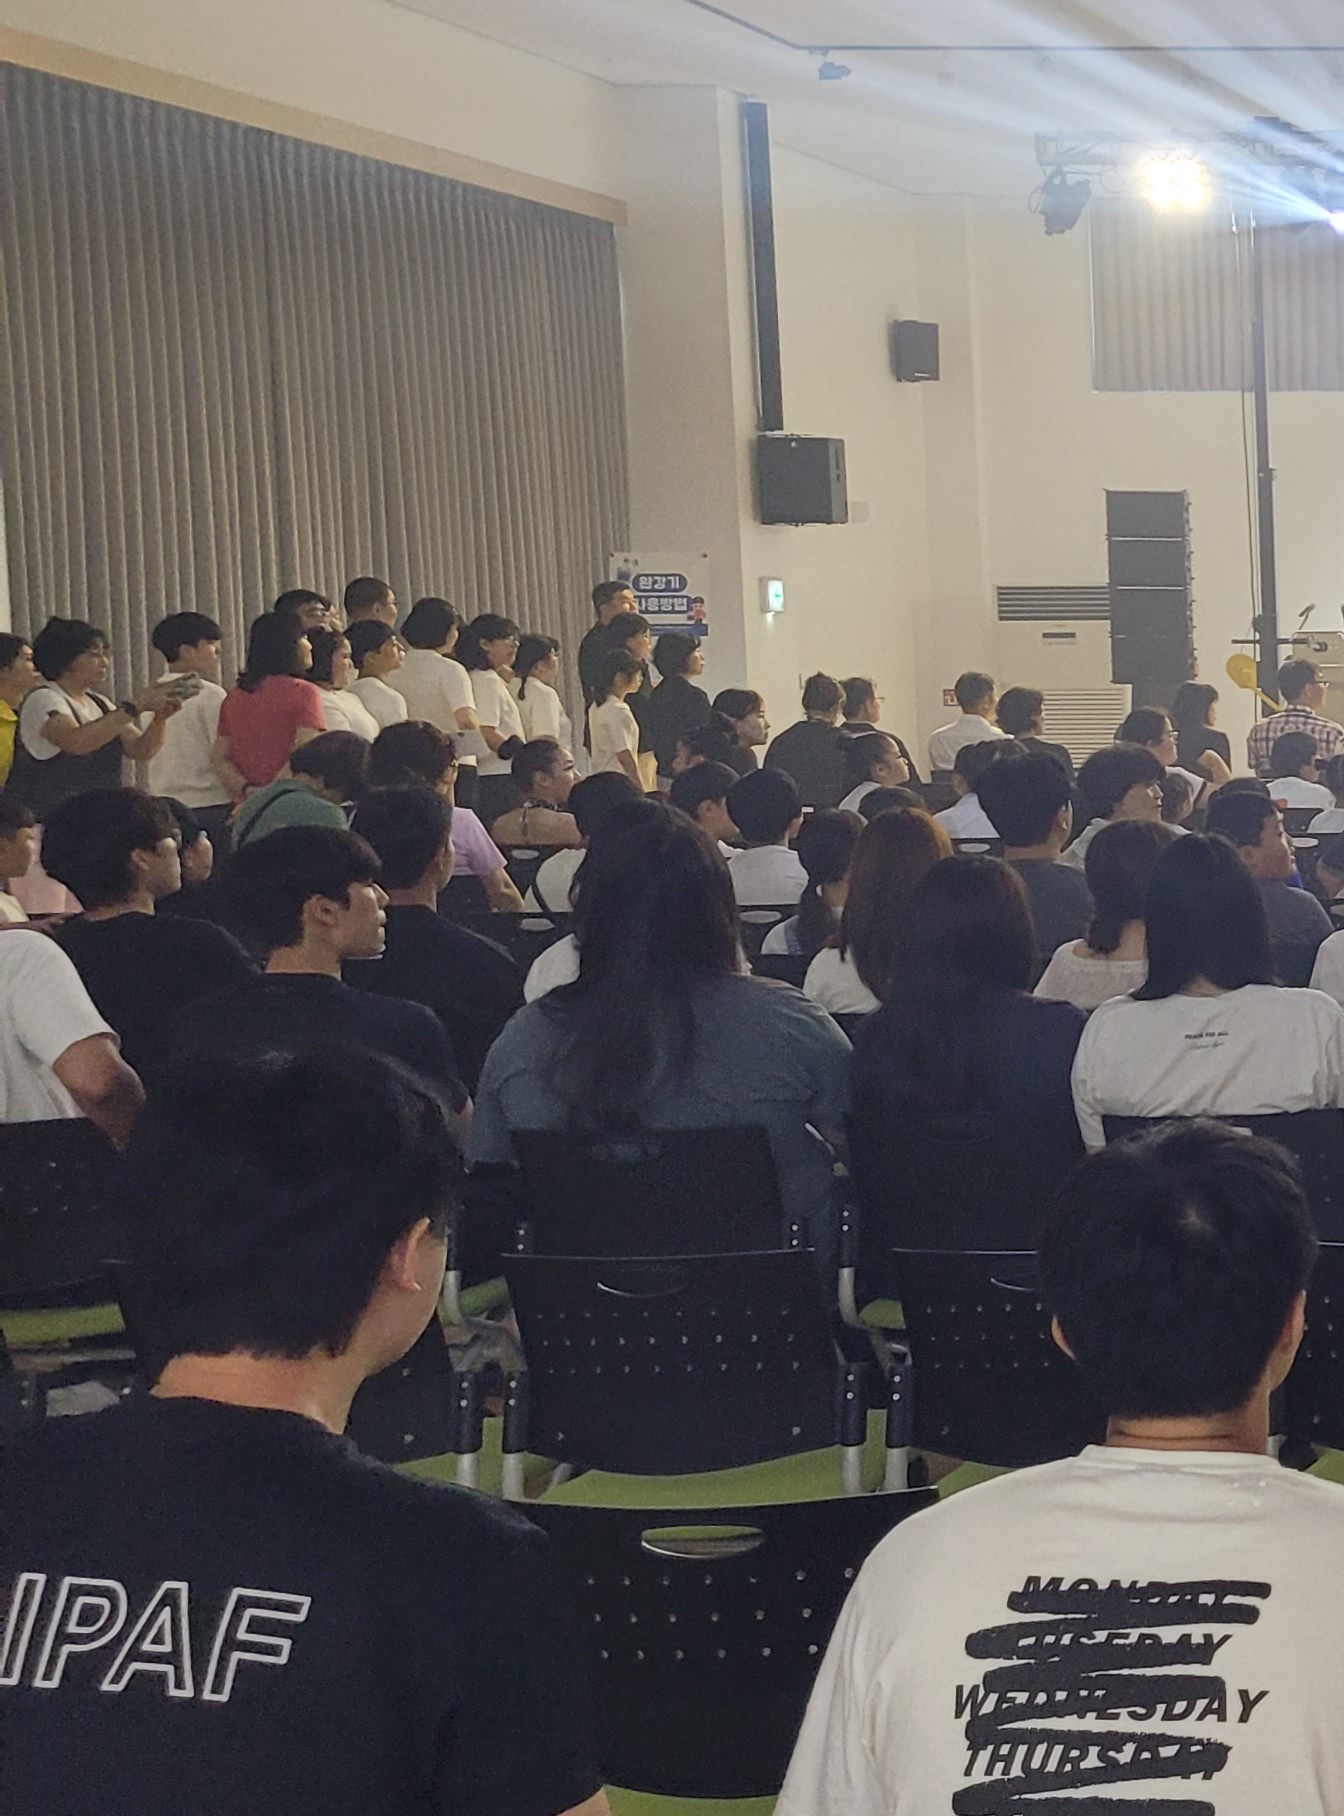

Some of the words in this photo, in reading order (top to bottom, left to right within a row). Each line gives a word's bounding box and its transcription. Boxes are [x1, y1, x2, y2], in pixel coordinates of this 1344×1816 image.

[638, 597, 688, 611] 용방법
[0, 1572, 312, 1702] IPAF
[962, 1736, 1234, 1782] THURSD
